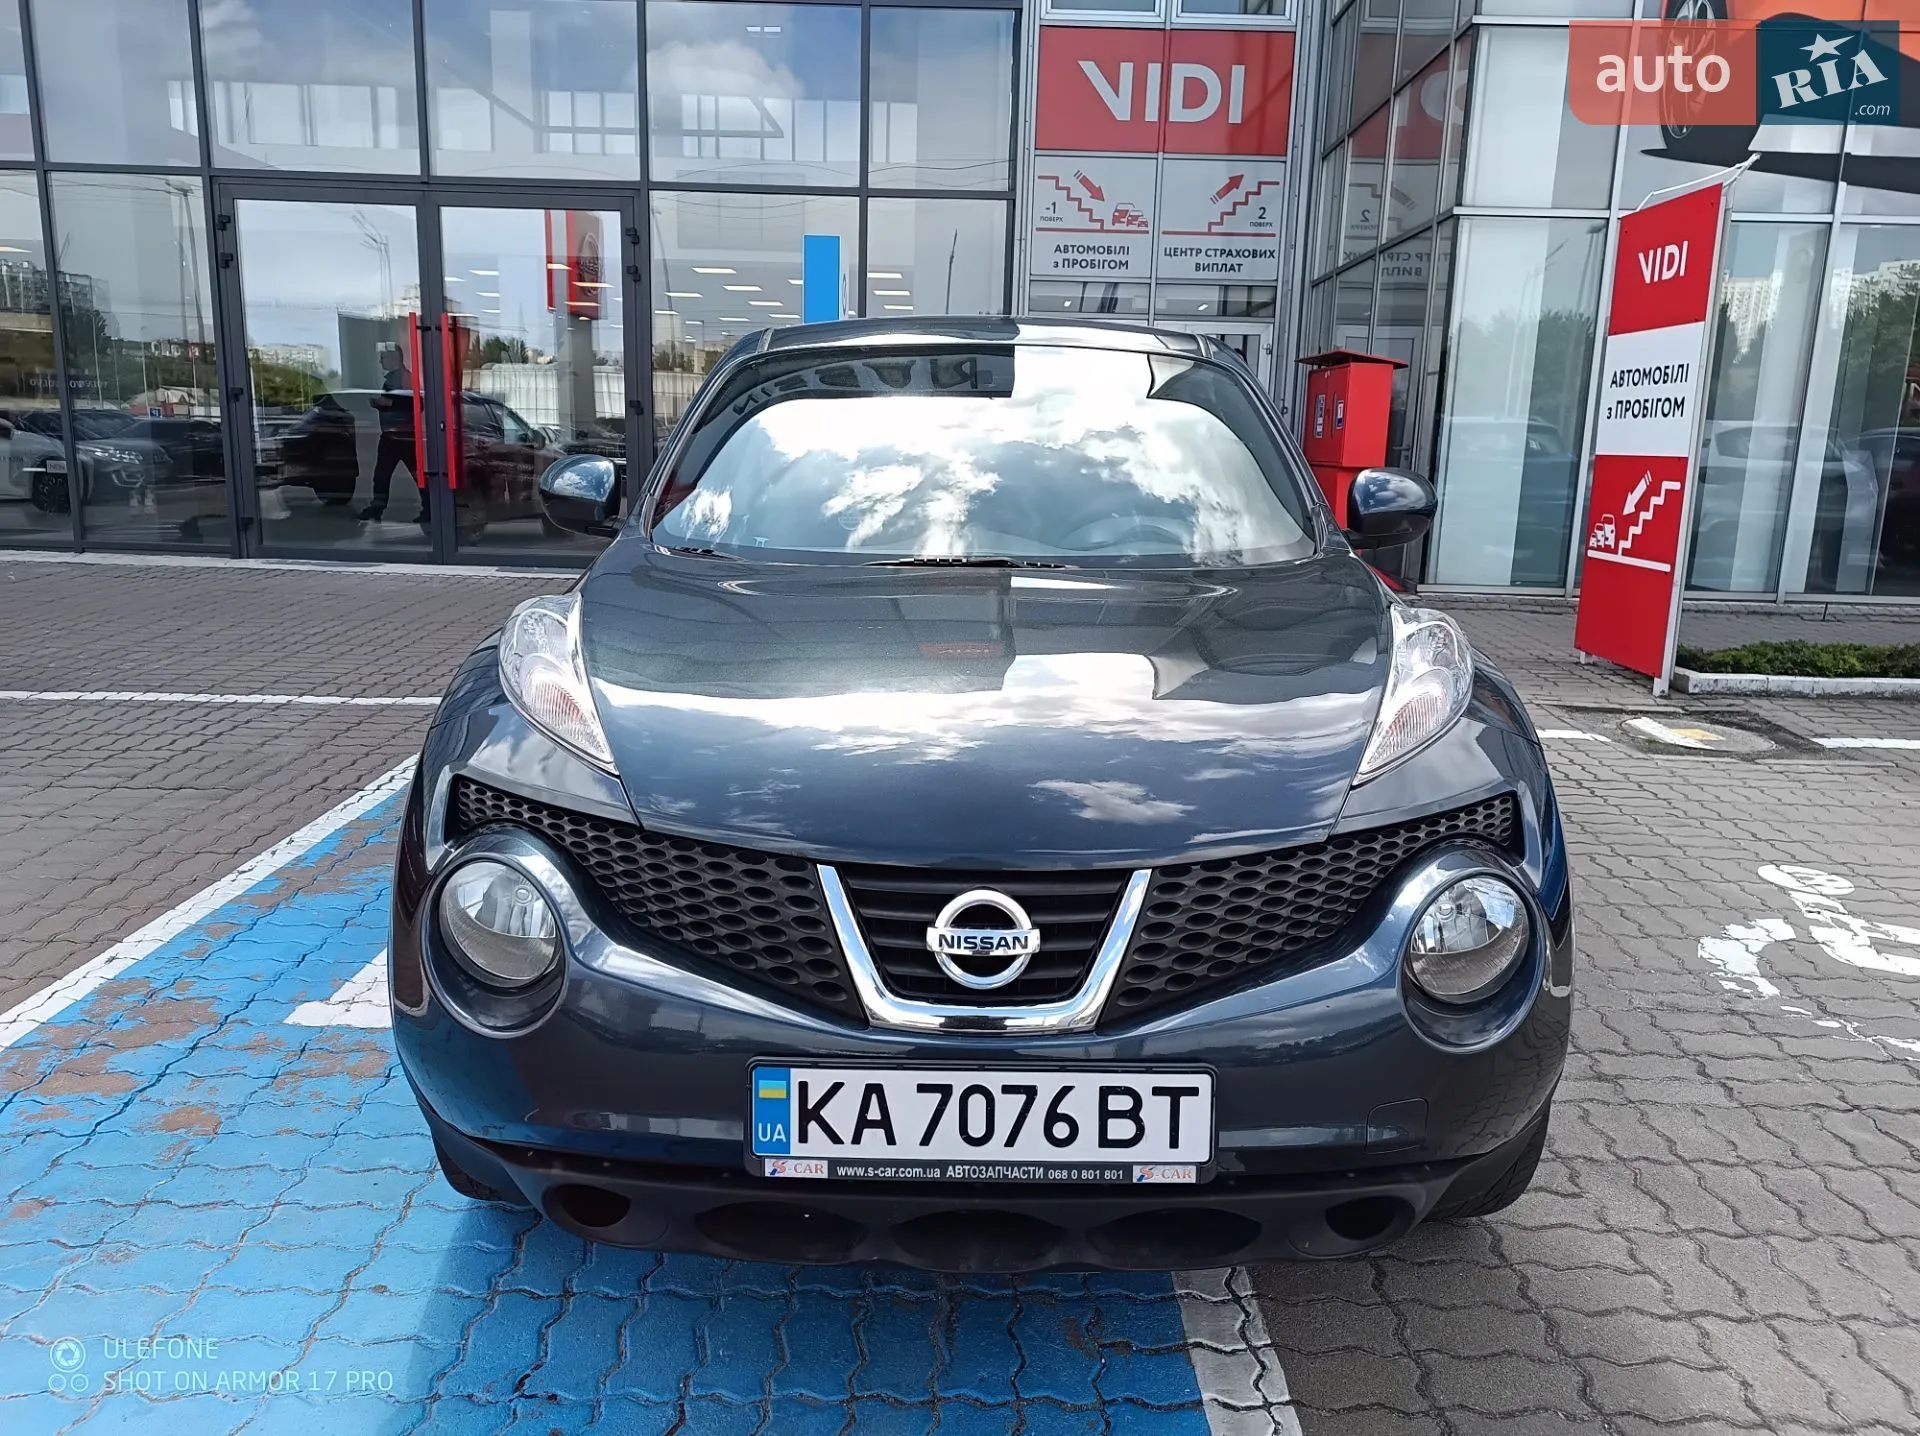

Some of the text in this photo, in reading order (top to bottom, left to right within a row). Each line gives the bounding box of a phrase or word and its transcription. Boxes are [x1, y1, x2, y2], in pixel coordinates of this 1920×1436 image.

[1077, 60, 1246, 124] VIDI
[1258, 206, 1267, 220] 2
[1053, 243, 1130, 256] АВТОМОБІЛІ
[1163, 247, 1277, 260] ЦЕНТР СТРАХОВИХ
[1062, 257, 1129, 270] ПРОБІГОМ
[1194, 262, 1244, 274] ВИПЛАТ
[1637, 240, 1690, 285] VIDI
[1609, 362, 1690, 389] АВТОМОБІЛІ
[1614, 395, 1686, 420] ПРОБІГОМ
[938, 934, 1029, 951] NISSAN
[797, 1080, 1200, 1150] KA 7076 BT
[757, 1123, 787, 1143] UA
[836, 1164, 1124, 1180] www.s-car.com.ua АВТОЗАПЧАСТИ 068 0 801 801
